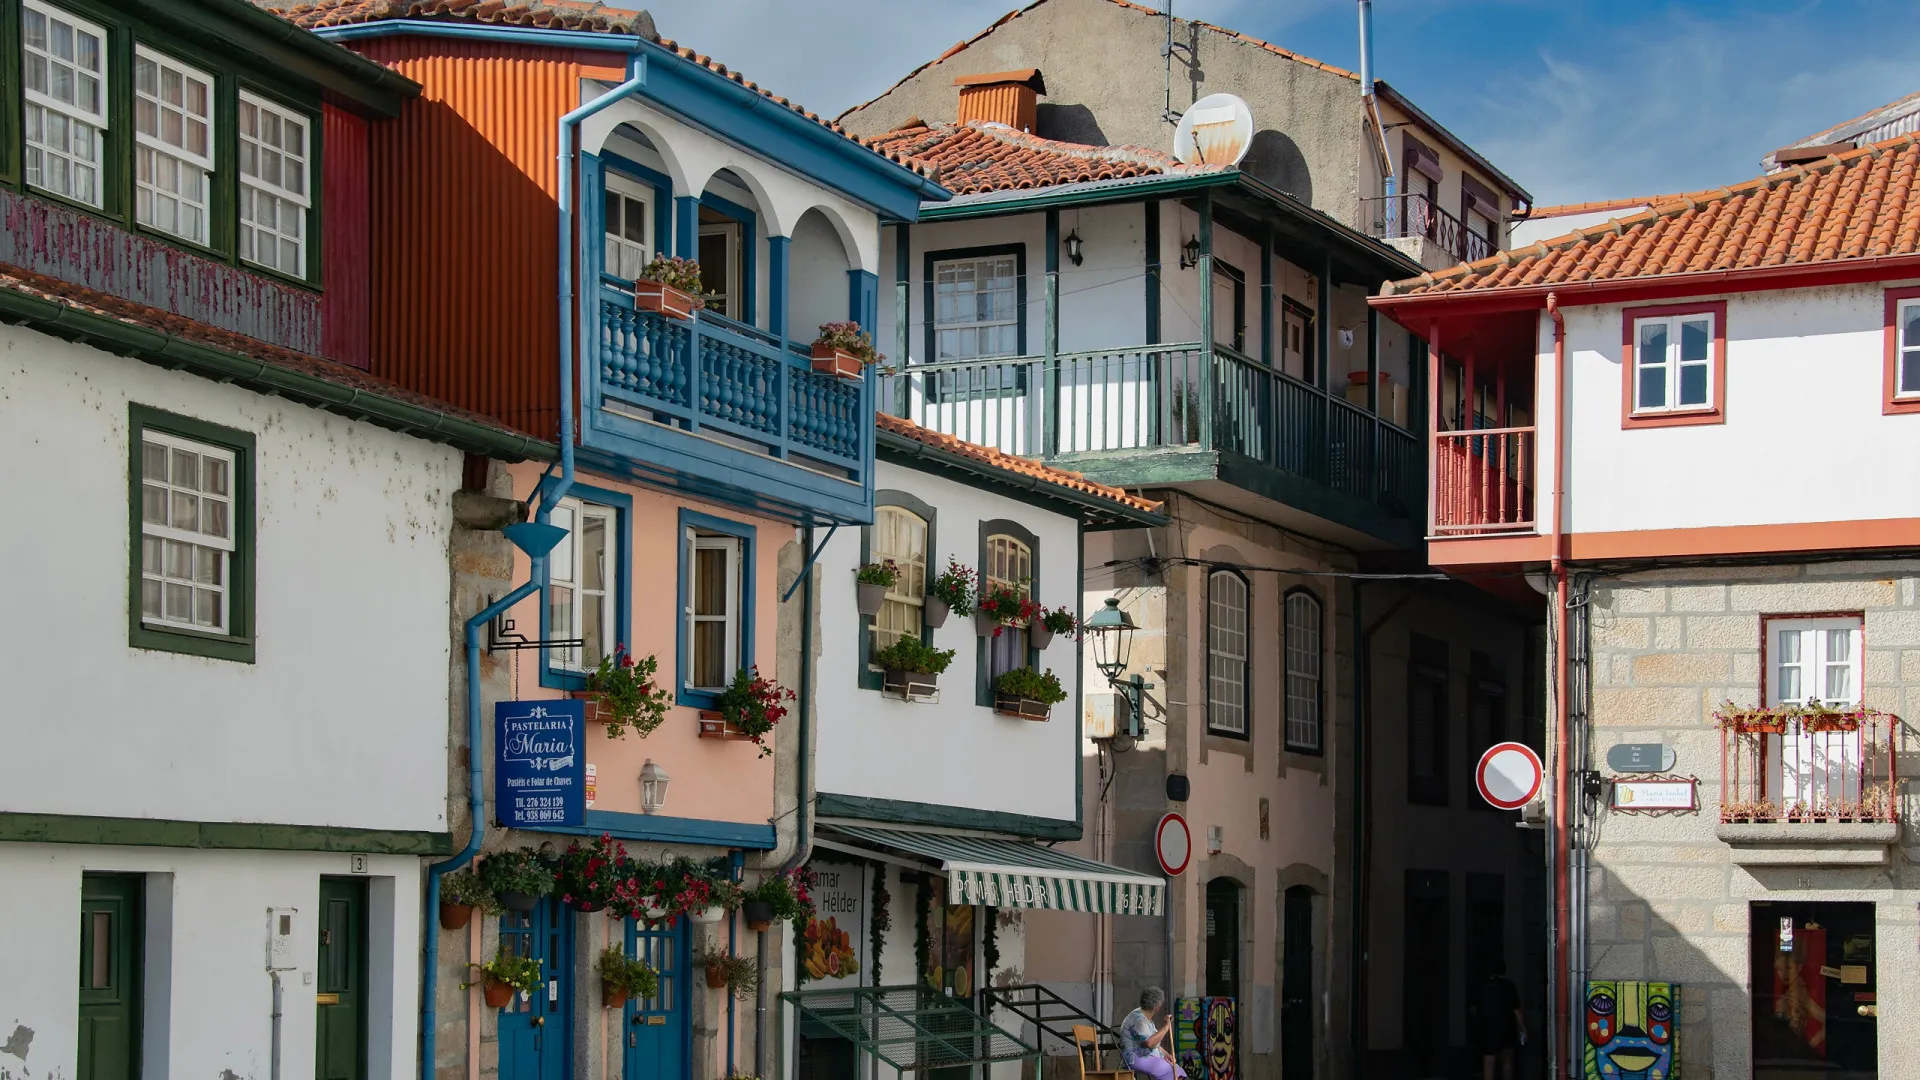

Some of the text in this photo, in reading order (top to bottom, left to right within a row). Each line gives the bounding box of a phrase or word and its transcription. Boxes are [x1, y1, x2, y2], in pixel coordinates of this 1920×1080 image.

[512, 721, 567, 731] PASTELARIA
[509, 732, 568, 755] Maria
[507, 778, 526, 787] Pastéis
[546, 777, 553, 786] de
[554, 776, 572, 786] Chaves
[526, 797, 539, 807] 276
[540, 797, 551, 807] 324
[553, 796, 564, 807] 139
[515, 809, 565, 821] Tel. 938 069 642
[356, 857, 362, 869] 3
[958, 879, 1000, 905] POMAR
[822, 891, 857, 913] Hélder
